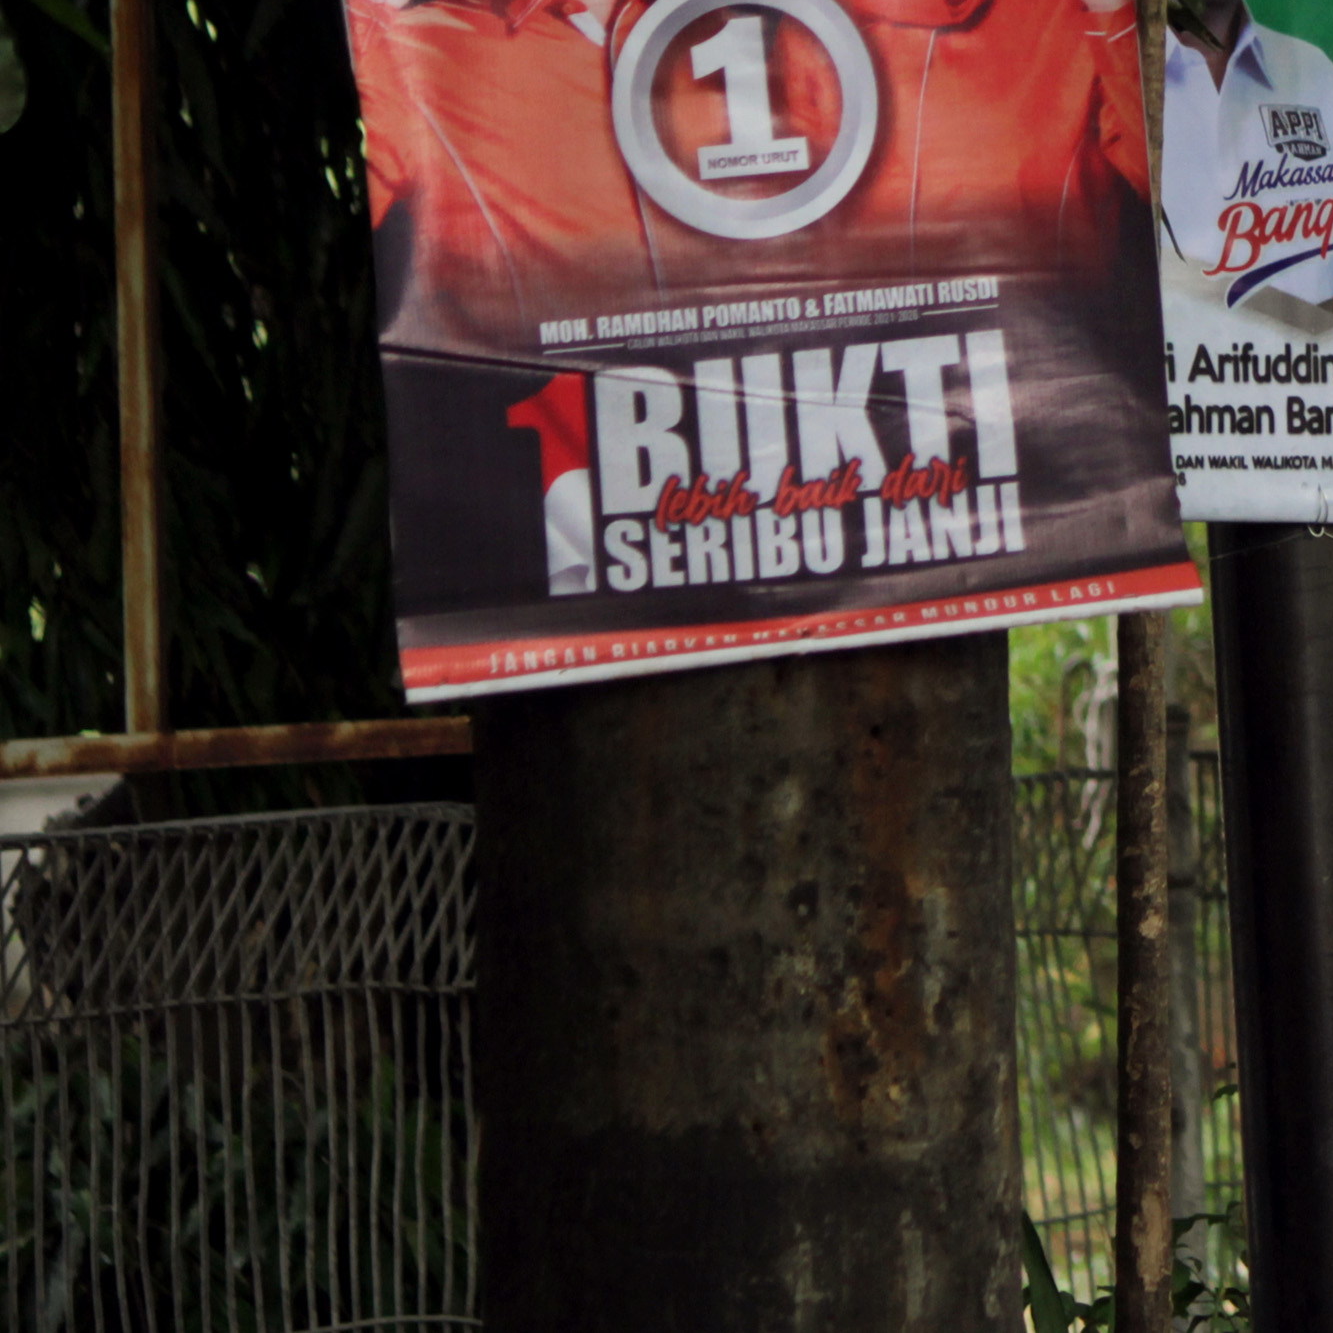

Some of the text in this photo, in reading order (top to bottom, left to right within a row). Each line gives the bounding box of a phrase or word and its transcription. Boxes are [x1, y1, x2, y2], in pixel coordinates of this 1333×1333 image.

[690, 16, 782, 150] 1
[706, 149, 800, 171] NOMOR URUT
[1270, 109, 1326, 140] APPI
[539, 276, 999, 345] MOH. RAMDHAN POMANTO & FATMAWATI RUSDI
[594, 329, 1019, 516] BUKTI
[1168, 394, 1276, 435] ahman
[655, 453, 967, 532] lebih baik dari
[1175, 455, 1204, 469] DAN
[1208, 455, 1248, 470] WAKIL
[1252, 455, 1318, 470] WALIKOTA
[604, 481, 1026, 592] SERIBU JANJI
[488, 645, 597, 674] JANGAN
[921, 592, 1039, 621] MUNDUR
[1051, 581, 1117, 605] LAGI
